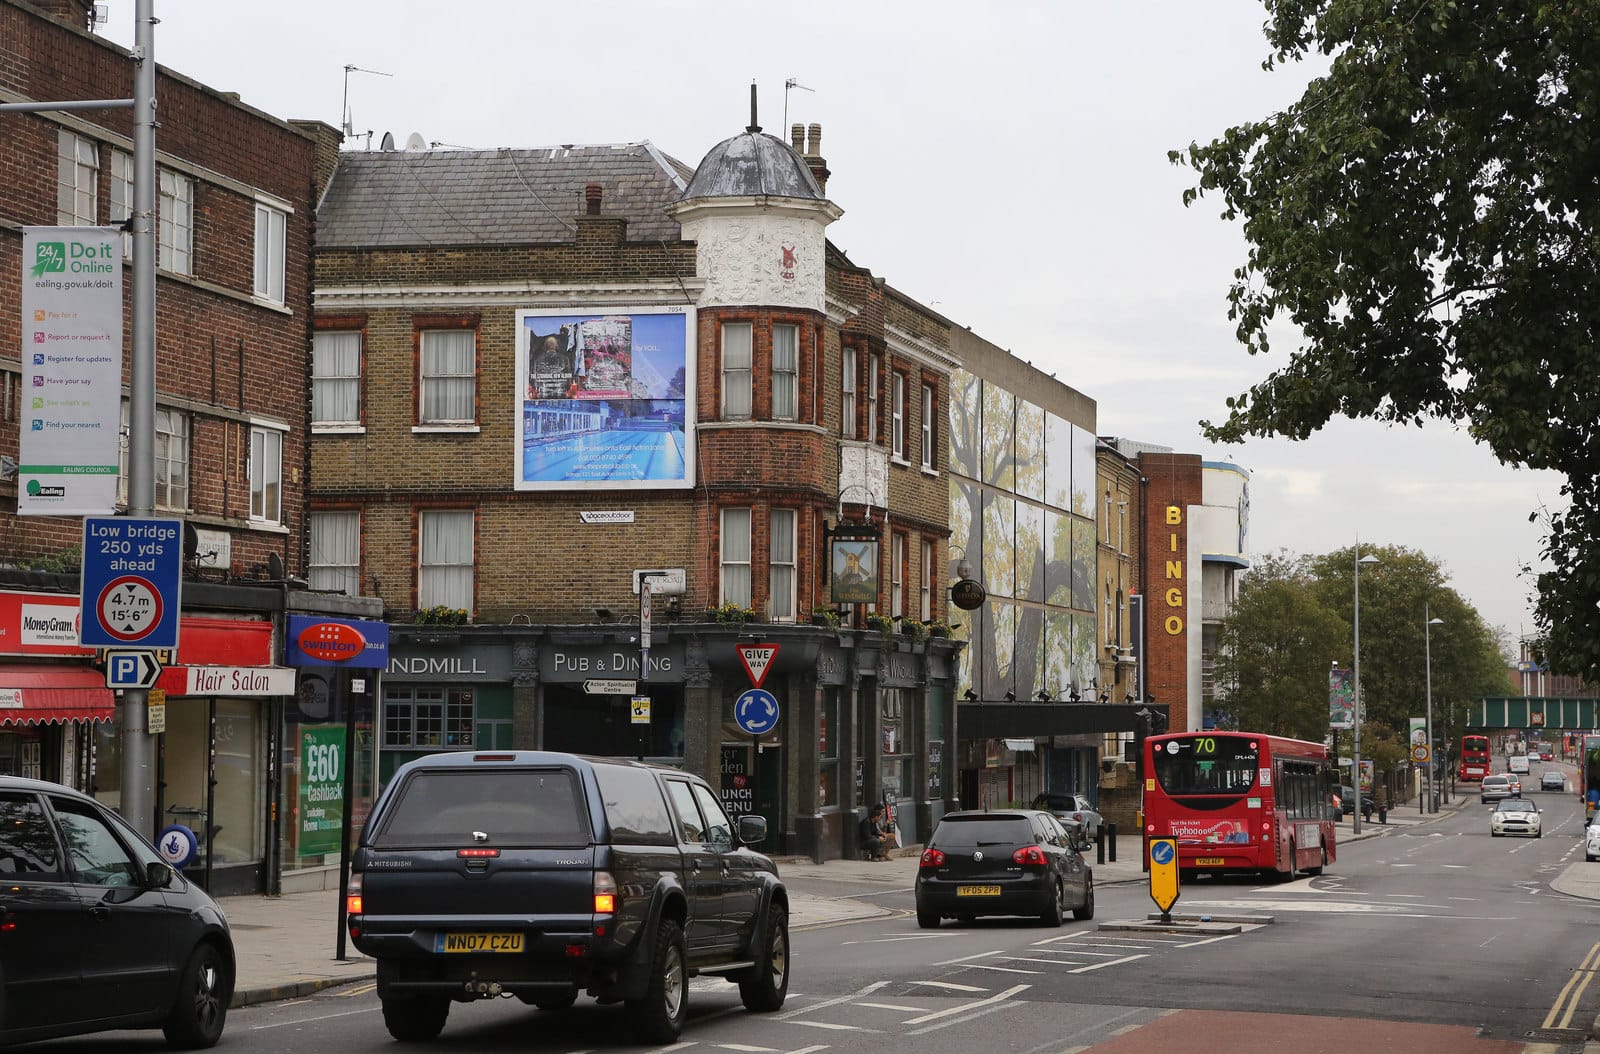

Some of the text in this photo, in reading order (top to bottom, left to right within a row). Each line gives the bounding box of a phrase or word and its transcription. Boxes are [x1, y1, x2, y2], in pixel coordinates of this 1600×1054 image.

[38, 245, 64, 270] 24/7
[70, 242, 113, 258] Do it
[70, 261, 113, 273] Online
[35, 280, 113, 290] ealing.gov.uk/doit
[47, 334, 70, 342] Report
[47, 356, 74, 364] Register
[40, 487, 64, 495] Ealing
[91, 523, 176, 541] Low bridge
[100, 541, 164, 556] 250 yds
[110, 557, 155, 571] ahead
[1164, 505, 1183, 635] BINGO
[111, 593, 150, 606] 4.7 m
[23, 616, 72, 634] MoneyGram
[303, 640, 357, 652] swinton
[596, 659, 606, 671] &
[744, 650, 770, 668] GIVE WAY
[117, 658, 135, 682] P
[195, 669, 226, 691] Hair
[231, 669, 270, 691] Salon
[1195, 738, 1216, 753] 70
[307, 743, 340, 782] £60
[307, 783, 343, 802] Cashback
[962, 886, 1000, 894] YF05 ZPR
[447, 934, 521, 949] WN07 CZU
